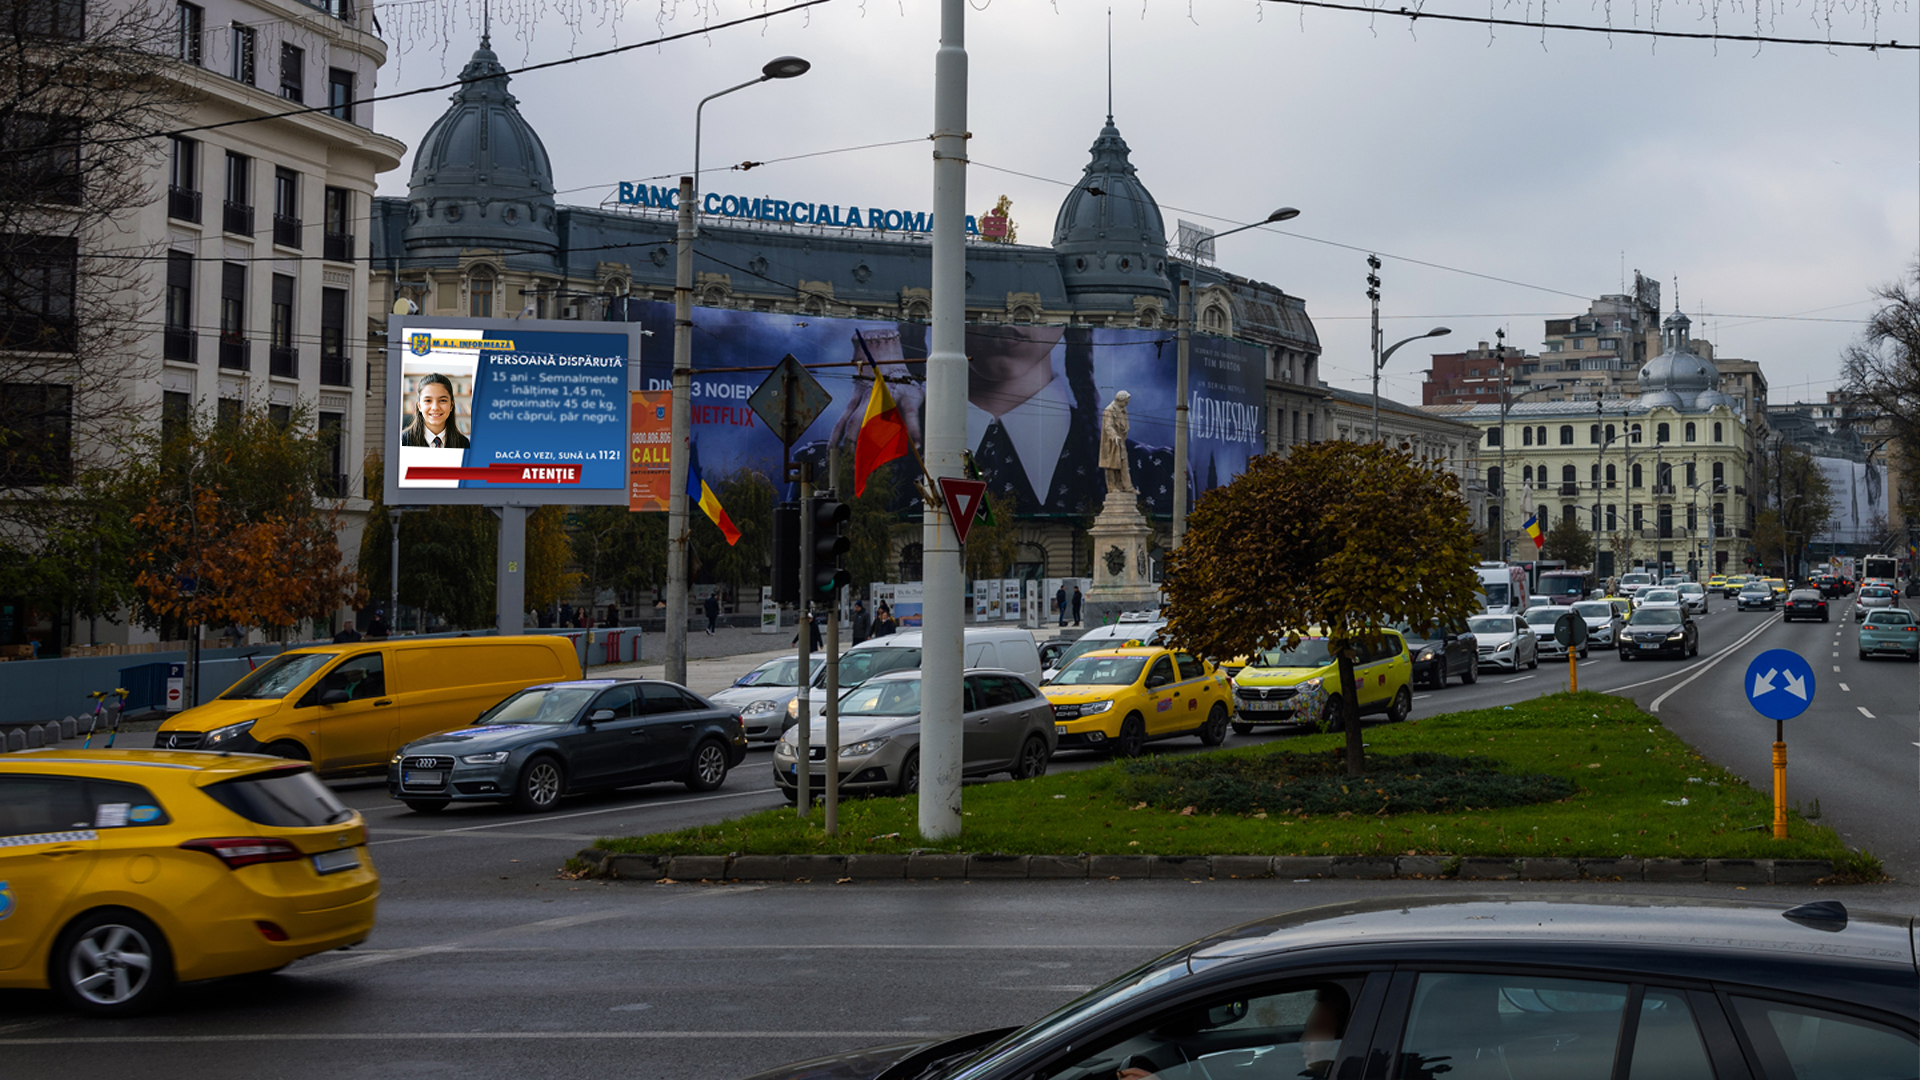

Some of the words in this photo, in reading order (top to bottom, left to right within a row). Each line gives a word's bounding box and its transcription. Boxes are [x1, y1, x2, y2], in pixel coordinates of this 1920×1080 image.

[619, 181, 690, 210] BANC
[704, 193, 863, 228] COMERCIALA
[869, 208, 979, 235] ROMA
[433, 340, 457, 348] M.A.I.
[490, 354, 556, 366] PERSOANĂ
[559, 355, 622, 368] DISPĂRUTĂ
[492, 371, 506, 382] 15
[510, 372, 528, 382] ani
[539, 372, 618, 384] Semnalmente
[563, 386, 587, 396] 1,45
[591, 389, 605, 397] m,
[691, 381, 702, 397] 3
[705, 382, 760, 399] NOIEM
[492, 398, 560, 409] aproximativ
[563, 399, 578, 409] 45
[582, 400, 596, 410] de
[599, 400, 617, 412] kg,
[489, 410, 513, 420] ochi
[517, 410, 556, 422] căprui,
[560, 412, 579, 423] păr
[583, 413, 619, 424] negru.
[691, 405, 754, 428] NETFLIX
[632, 432, 671, 444] 0800.806.806
[495, 451, 520, 459] DACĂ
[533, 452, 556, 460] VEZI,
[558, 451, 583, 459] SUNĂ
[586, 452, 597, 460] LA
[599, 450, 621, 460] 112!
[632, 447, 670, 463] CALL
[522, 468, 576, 484] ATENȚIE
[172, 667, 179, 675] P
